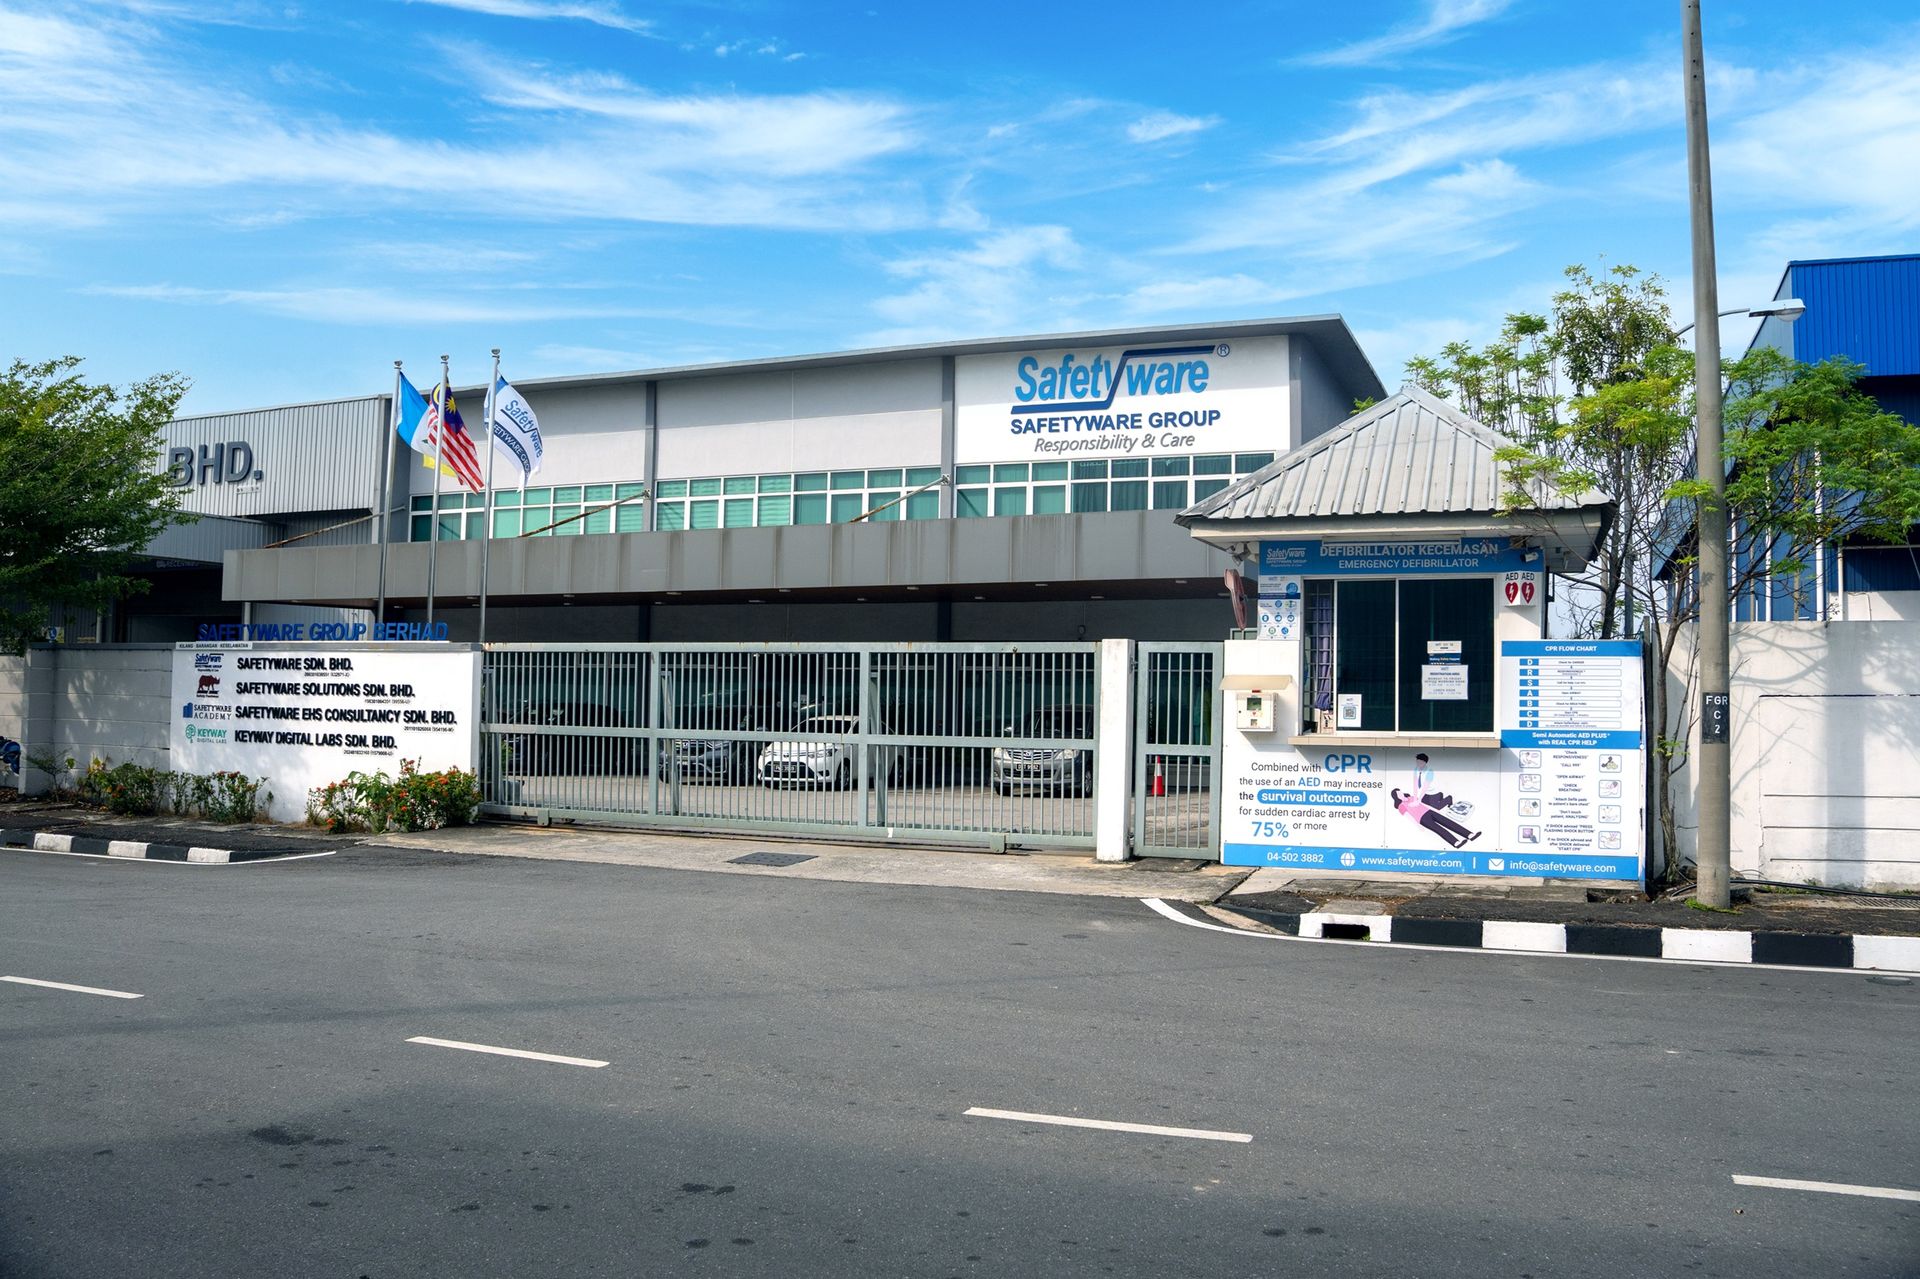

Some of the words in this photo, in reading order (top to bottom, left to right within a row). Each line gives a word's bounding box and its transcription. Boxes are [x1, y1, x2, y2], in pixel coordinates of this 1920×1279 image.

[1010, 413, 1142, 434] SAFETYWARE
[1148, 410, 1221, 428] GROUP
[1034, 433, 1139, 455] Responsibility
[1141, 435, 1156, 448] &
[1160, 432, 1195, 447] Care
[168, 441, 263, 487] BHD.
[1320, 544, 1415, 557] DEFIBRILLATOR
[1418, 543, 1498, 555] KECEMASAN
[1338, 559, 1400, 569] EMERGENCY
[1402, 558, 1479, 568] DEFIBRILLATOR
[1505, 572, 1518, 580] AED
[1521, 572, 1534, 580] AED
[198, 624, 304, 640] SAFETYWARE
[309, 623, 366, 640] GROUP
[373, 622, 449, 640] BERHAD
[237, 658, 302, 670] SAFETYWARE
[304, 658, 328, 670] SDN.
[329, 658, 354, 671] BHD.
[236, 682, 300, 695] SAFETYWARE
[302, 683, 361, 696] SOLUTIONS
[362, 684, 388, 698] SDN.
[390, 684, 416, 698] BHD.
[1706, 695, 1728, 706] FGR
[194, 704, 232, 712] SAFETYWARE
[194, 712, 232, 720] ACADEMY
[235, 706, 300, 720] SAFETYWARE
[302, 708, 323, 721] EHS
[324, 708, 401, 724] CONSULTANCY
[404, 710, 430, 724] SDN.
[431, 711, 458, 725] BHD.
[1714, 710, 1721, 720] C
[197, 728, 227, 738] KEYWAY
[1714, 724, 1721, 734] 2
[234, 730, 274, 744] KEYWAY
[275, 732, 314, 746] DIGITAL
[316, 733, 342, 747] LABS
[345, 734, 370, 748] SDN.
[372, 735, 398, 749] BHD.
[1251, 762, 1299, 773] Combined
[1302, 763, 1322, 773] with
[1324, 753, 1372, 774] CPR
[1239, 777, 1254, 786] the
[1273, 778, 1282, 786] of
[1298, 777, 1321, 787] AED
[1324, 781, 1342, 790] may
[1344, 779, 1383, 789] increase
[1239, 792, 1254, 800] the
[1261, 791, 1306, 802] survival
[1309, 794, 1361, 804] outcome
[1239, 806, 1252, 816] for
[1254, 807, 1289, 817] sudden
[1291, 808, 1326, 818] cardiac
[1328, 810, 1356, 820] arrest
[1358, 810, 1370, 820] by
[1251, 820, 1290, 838] 75%
[1292, 822, 1302, 830] or
[1304, 822, 1328, 831] more
[1267, 852, 1299, 863] 04-502
[1301, 852, 1324, 864] 3882
[1361, 856, 1462, 869] www.safetyware.com
[1510, 860, 1617, 874] info@safetyware.com
